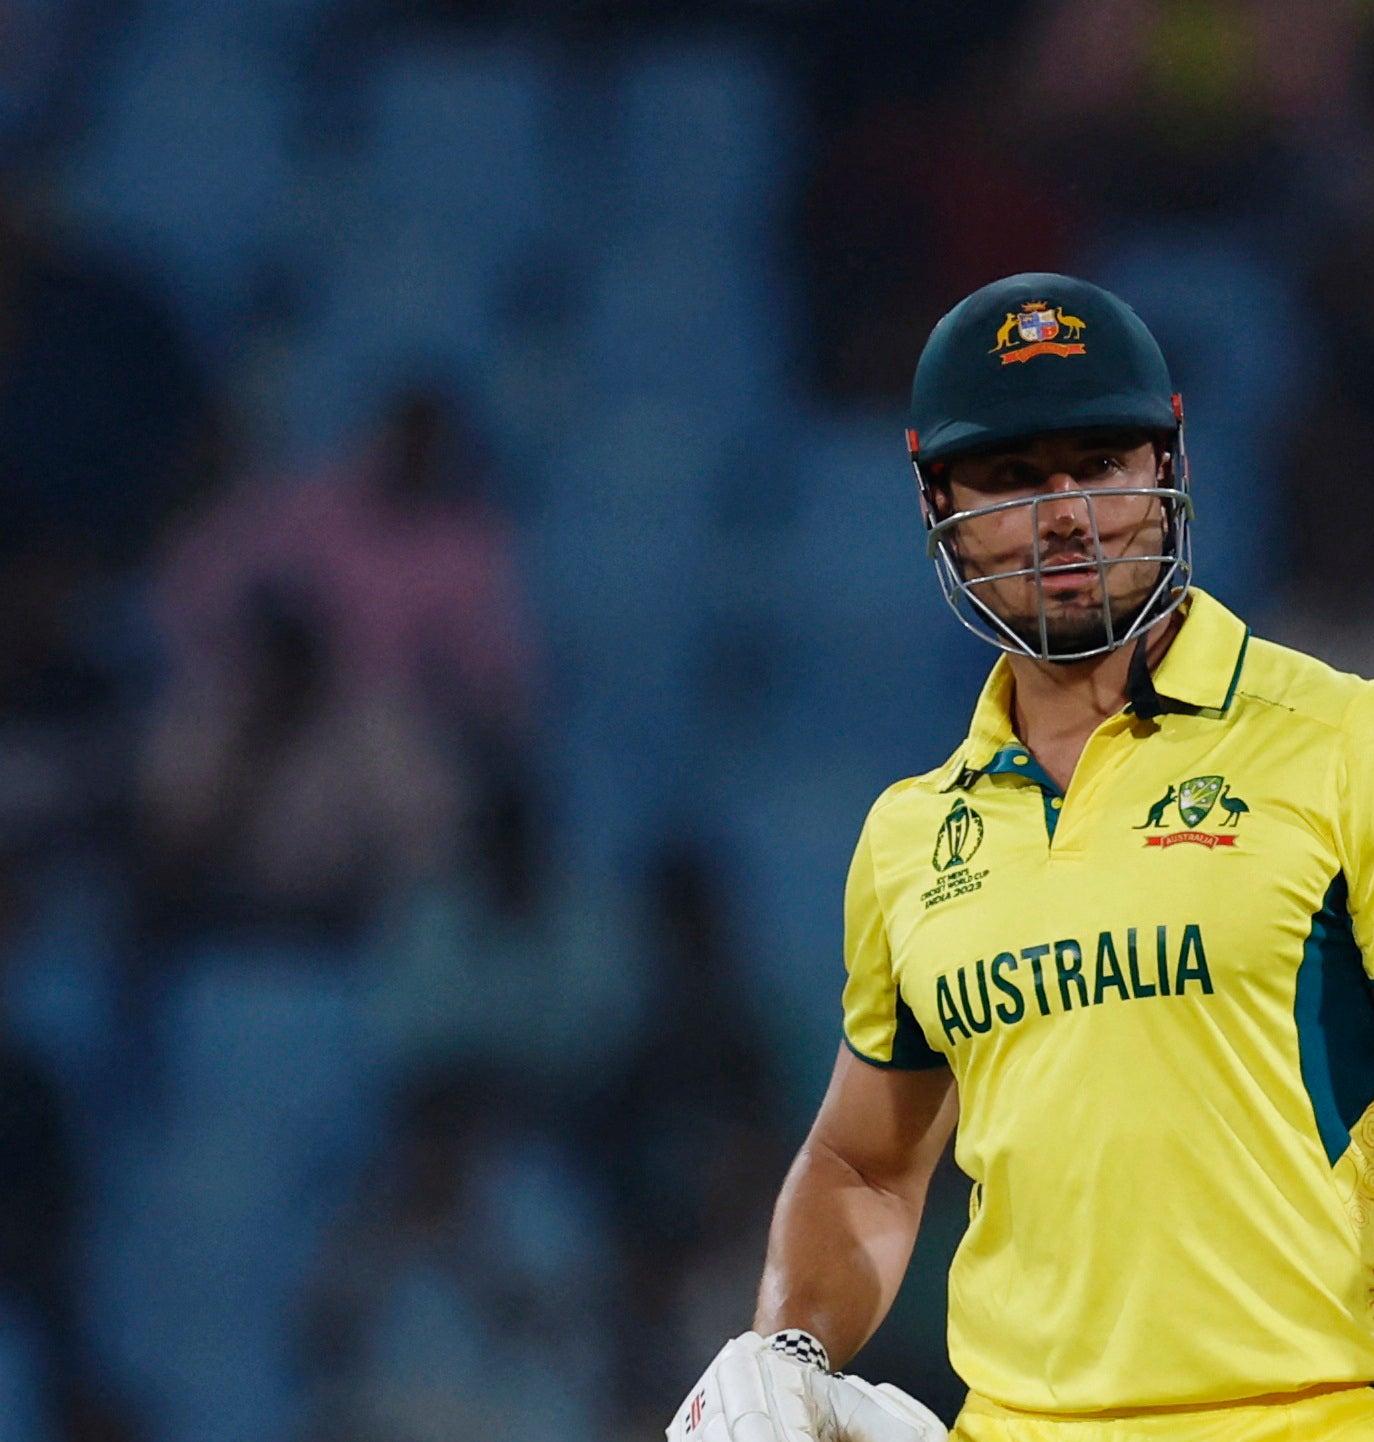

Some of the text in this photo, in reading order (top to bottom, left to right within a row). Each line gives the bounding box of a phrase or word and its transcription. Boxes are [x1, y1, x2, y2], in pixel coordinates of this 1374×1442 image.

[1166, 833, 1214, 845] AUSTRALIA
[953, 881, 982, 898] 2023
[936, 924, 1215, 1047] AUSTRALIA
